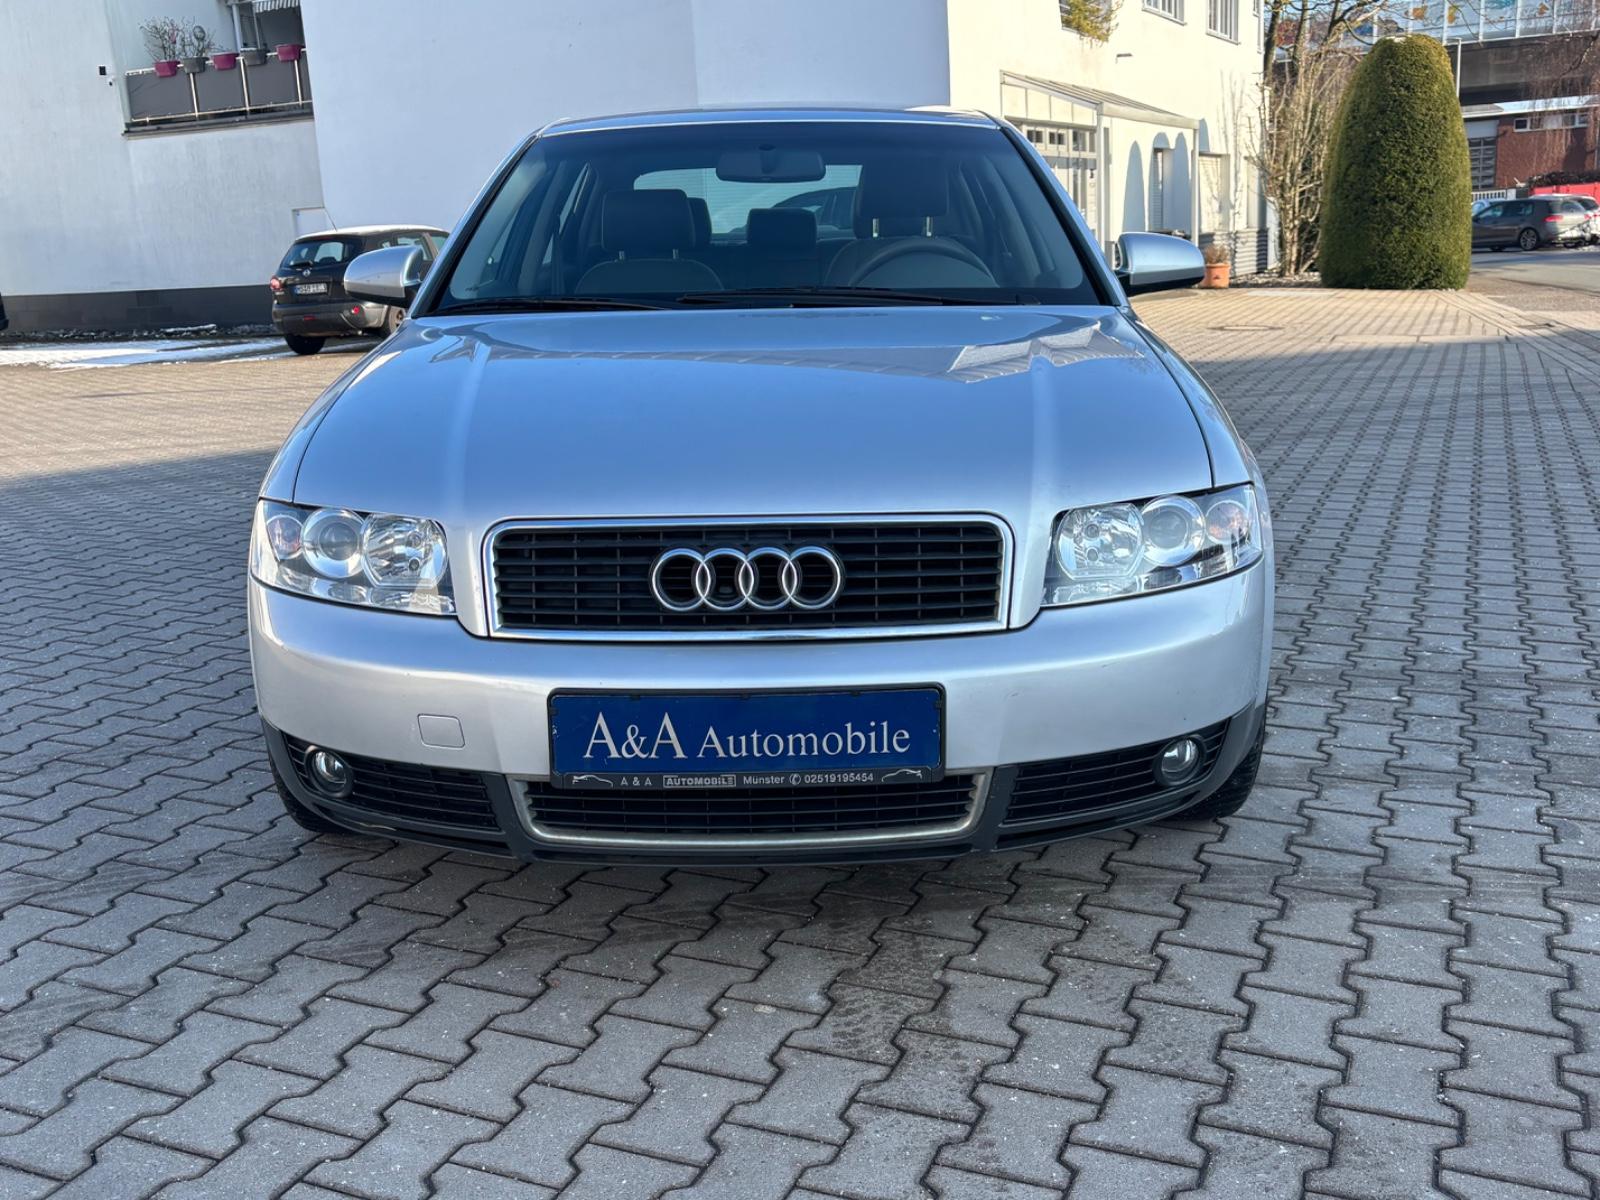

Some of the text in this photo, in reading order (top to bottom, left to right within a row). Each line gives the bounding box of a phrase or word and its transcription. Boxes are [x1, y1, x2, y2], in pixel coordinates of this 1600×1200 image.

[582, 711, 911, 759] A&A Automobile
[620, 776, 629, 786] A
[632, 776, 640, 786] &
[644, 776, 652, 786] A
[804, 773, 874, 784] 02519195454
